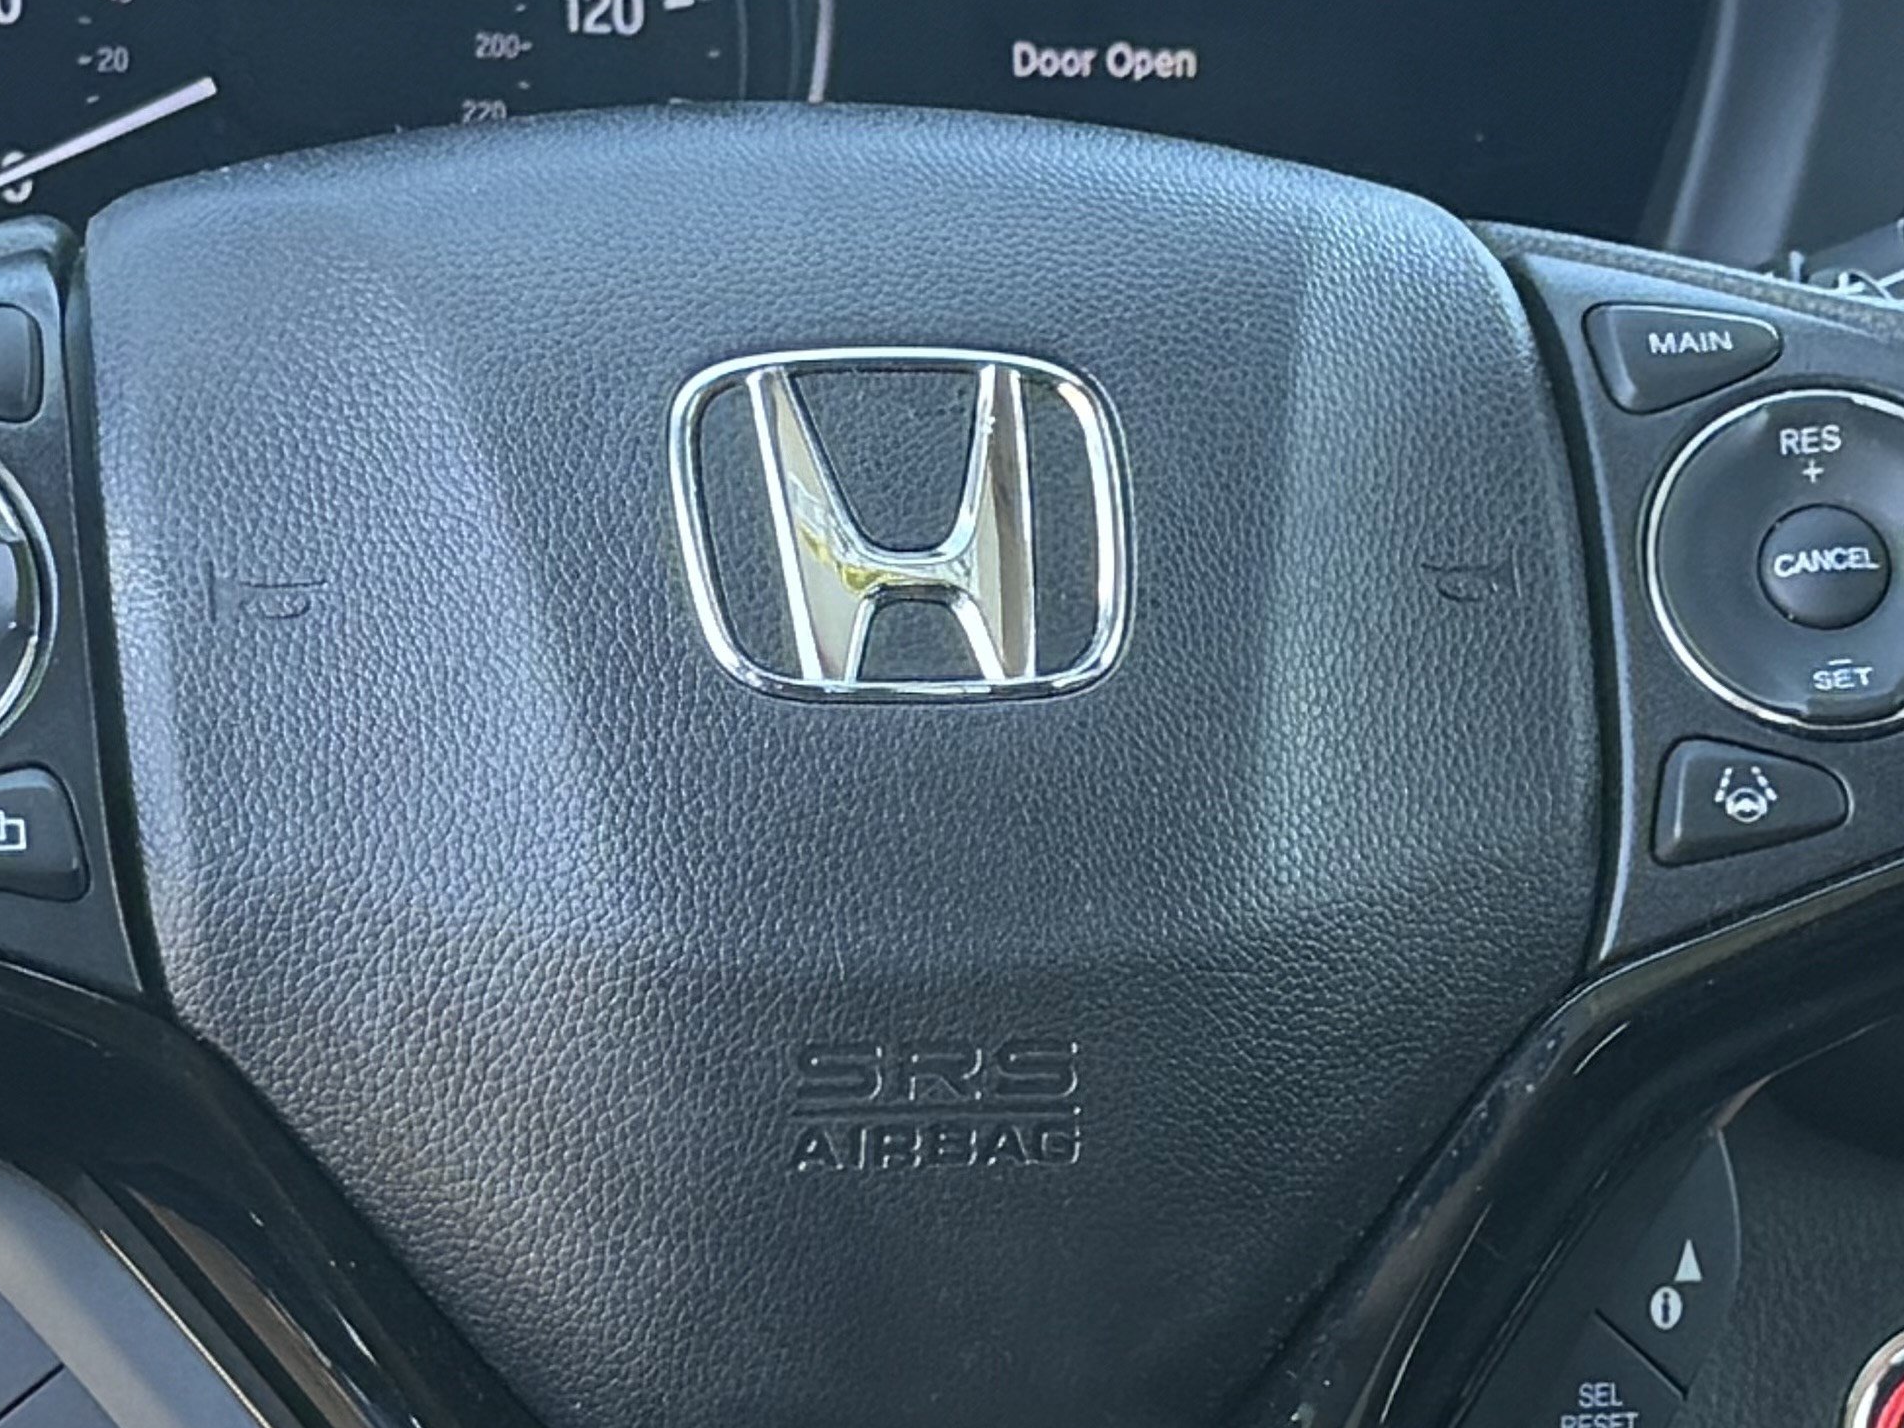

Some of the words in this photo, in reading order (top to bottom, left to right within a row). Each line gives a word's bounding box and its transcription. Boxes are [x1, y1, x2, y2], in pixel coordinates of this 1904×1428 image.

[98, 45, 129, 73] 20
[475, 33, 519, 59] 200
[1013, 41, 1096, 78] Door
[1106, 41, 1197, 81] Open
[1648, 330, 1734, 356] MAIN
[1779, 424, 1843, 455] RES
[1772, 547, 1880, 580] CANCEL
[1812, 664, 1874, 691] SET
[796, 1042, 1082, 1104] SRS
[798, 1124, 1082, 1171] AIRBAG
[1578, 1382, 1624, 1411] SEL
